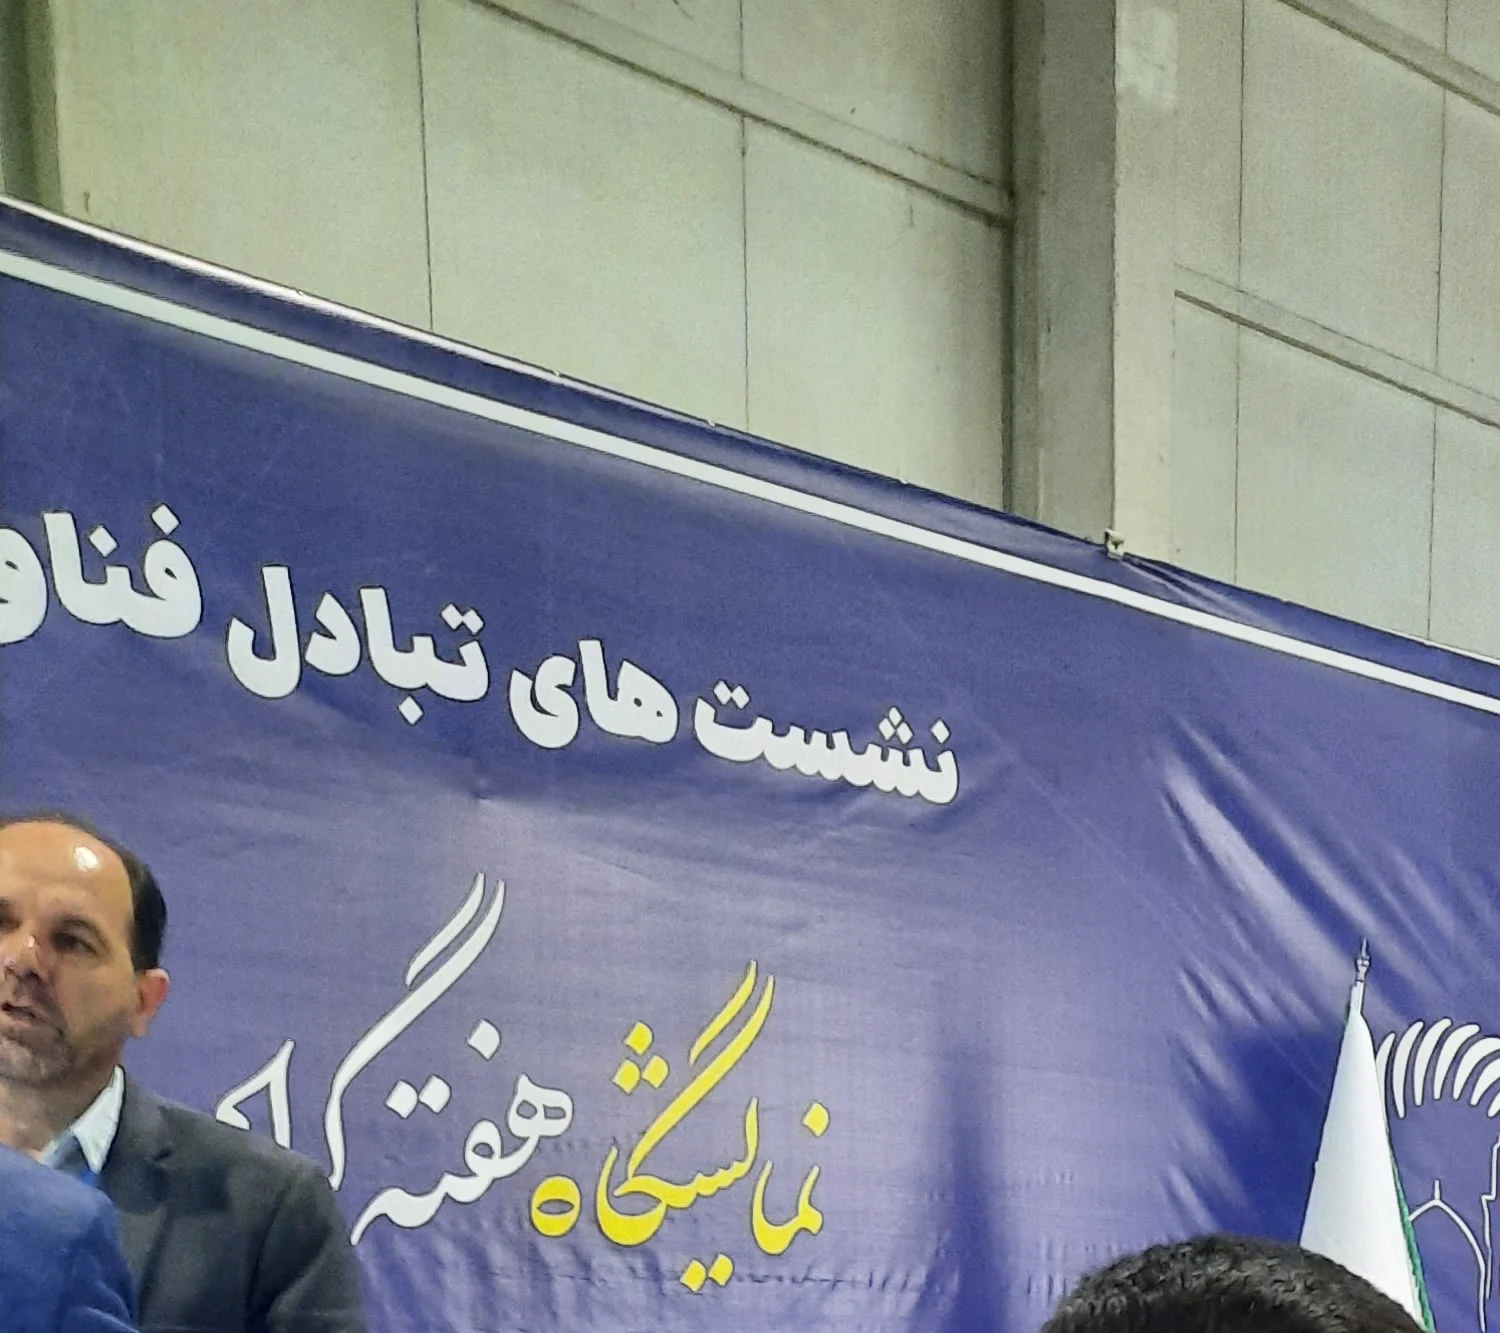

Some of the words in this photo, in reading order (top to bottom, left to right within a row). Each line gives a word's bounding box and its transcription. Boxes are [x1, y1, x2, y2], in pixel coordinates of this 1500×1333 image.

[226, 565, 491, 726] تبادل
[509, 639, 680, 750] های
[694, 679, 960, 805] نشست
[529, 959, 830, 1292] نمایشگاه
